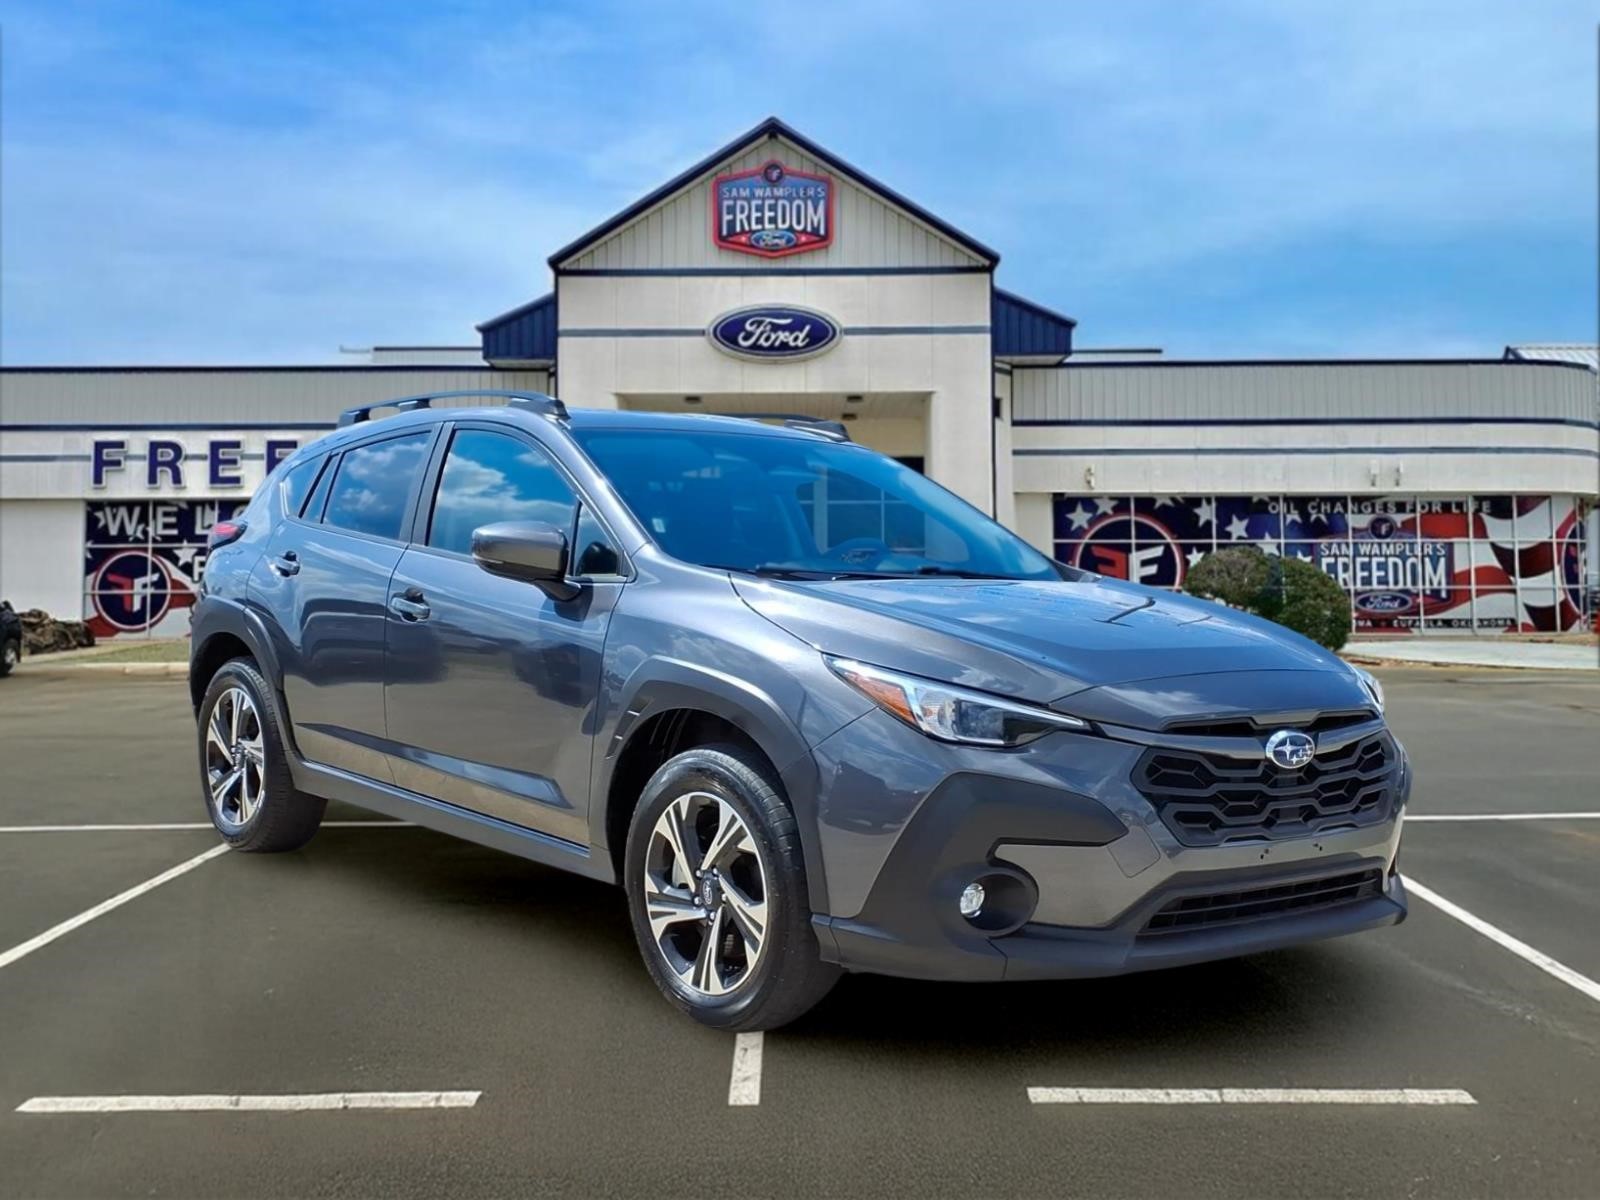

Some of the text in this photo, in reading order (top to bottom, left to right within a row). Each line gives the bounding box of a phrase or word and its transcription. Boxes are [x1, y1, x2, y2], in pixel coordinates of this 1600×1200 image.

[723, 187, 750, 198] SAM
[721, 200, 825, 236] FREEDOM
[738, 316, 811, 347] Ford
[104, 505, 246, 536] WEL
[1268, 501, 1492, 514] OIL CHANGES FOR LIFE
[1320, 557, 1447, 599] FREEDOM
[1366, 596, 1399, 609] Ford
